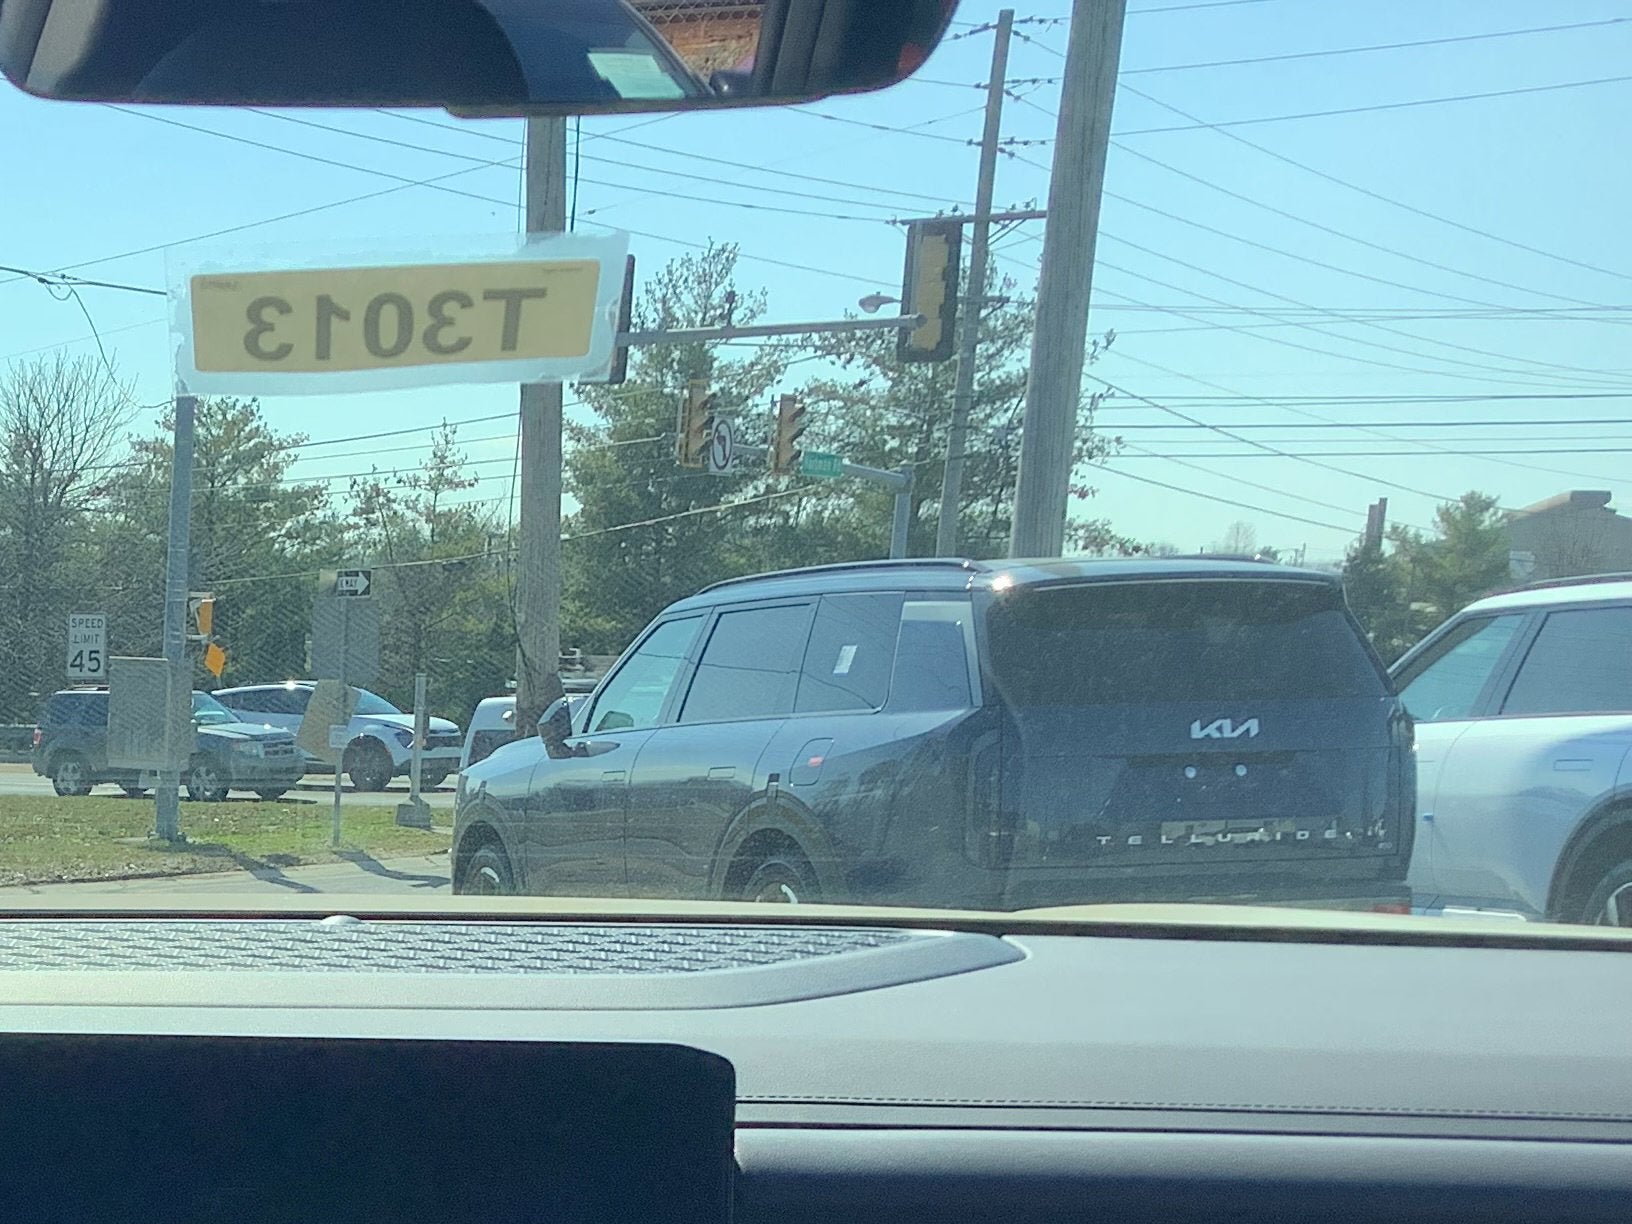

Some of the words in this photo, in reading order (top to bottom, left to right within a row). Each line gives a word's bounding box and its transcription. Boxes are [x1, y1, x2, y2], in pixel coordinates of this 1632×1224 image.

[71, 617, 104, 629] SPEED
[71, 633, 100, 644] LIMIT
[69, 649, 101, 673] 45
[1190, 718, 1260, 740] KIA
